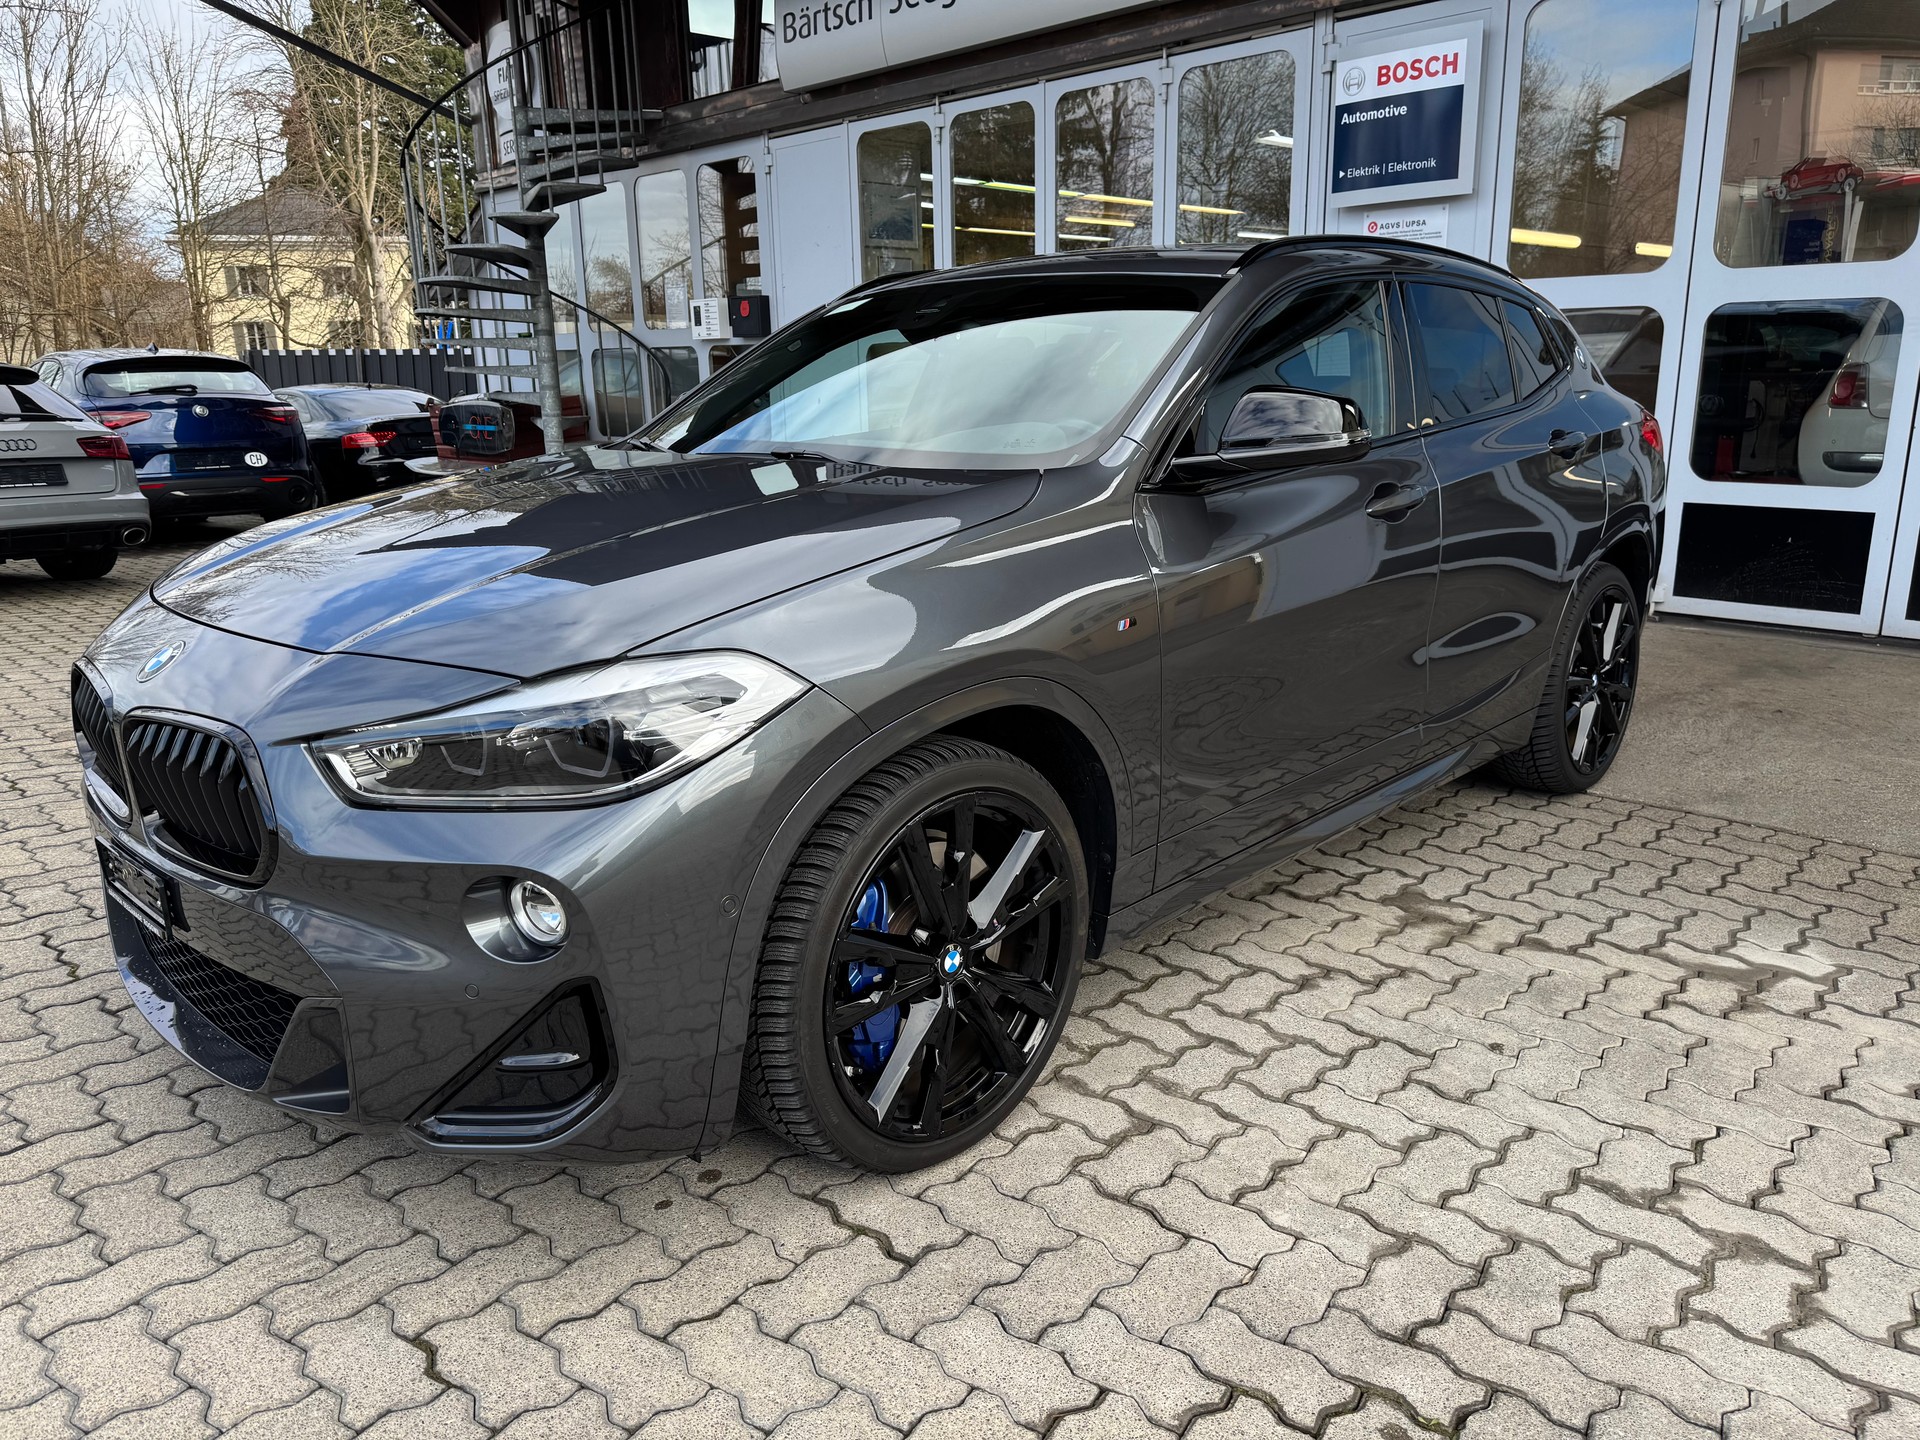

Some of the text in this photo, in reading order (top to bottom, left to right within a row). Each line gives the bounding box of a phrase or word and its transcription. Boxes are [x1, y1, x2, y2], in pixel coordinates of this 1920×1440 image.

[783, 0, 874, 44] Bärtsch
[1377, 52, 1459, 87] BOSCH
[1341, 104, 1408, 125] Automotive
[1347, 158, 1437, 179] Elektrik Elektronik
[1379, 219, 1427, 230] AGVS UPSA
[249, 454, 264, 465] CH
